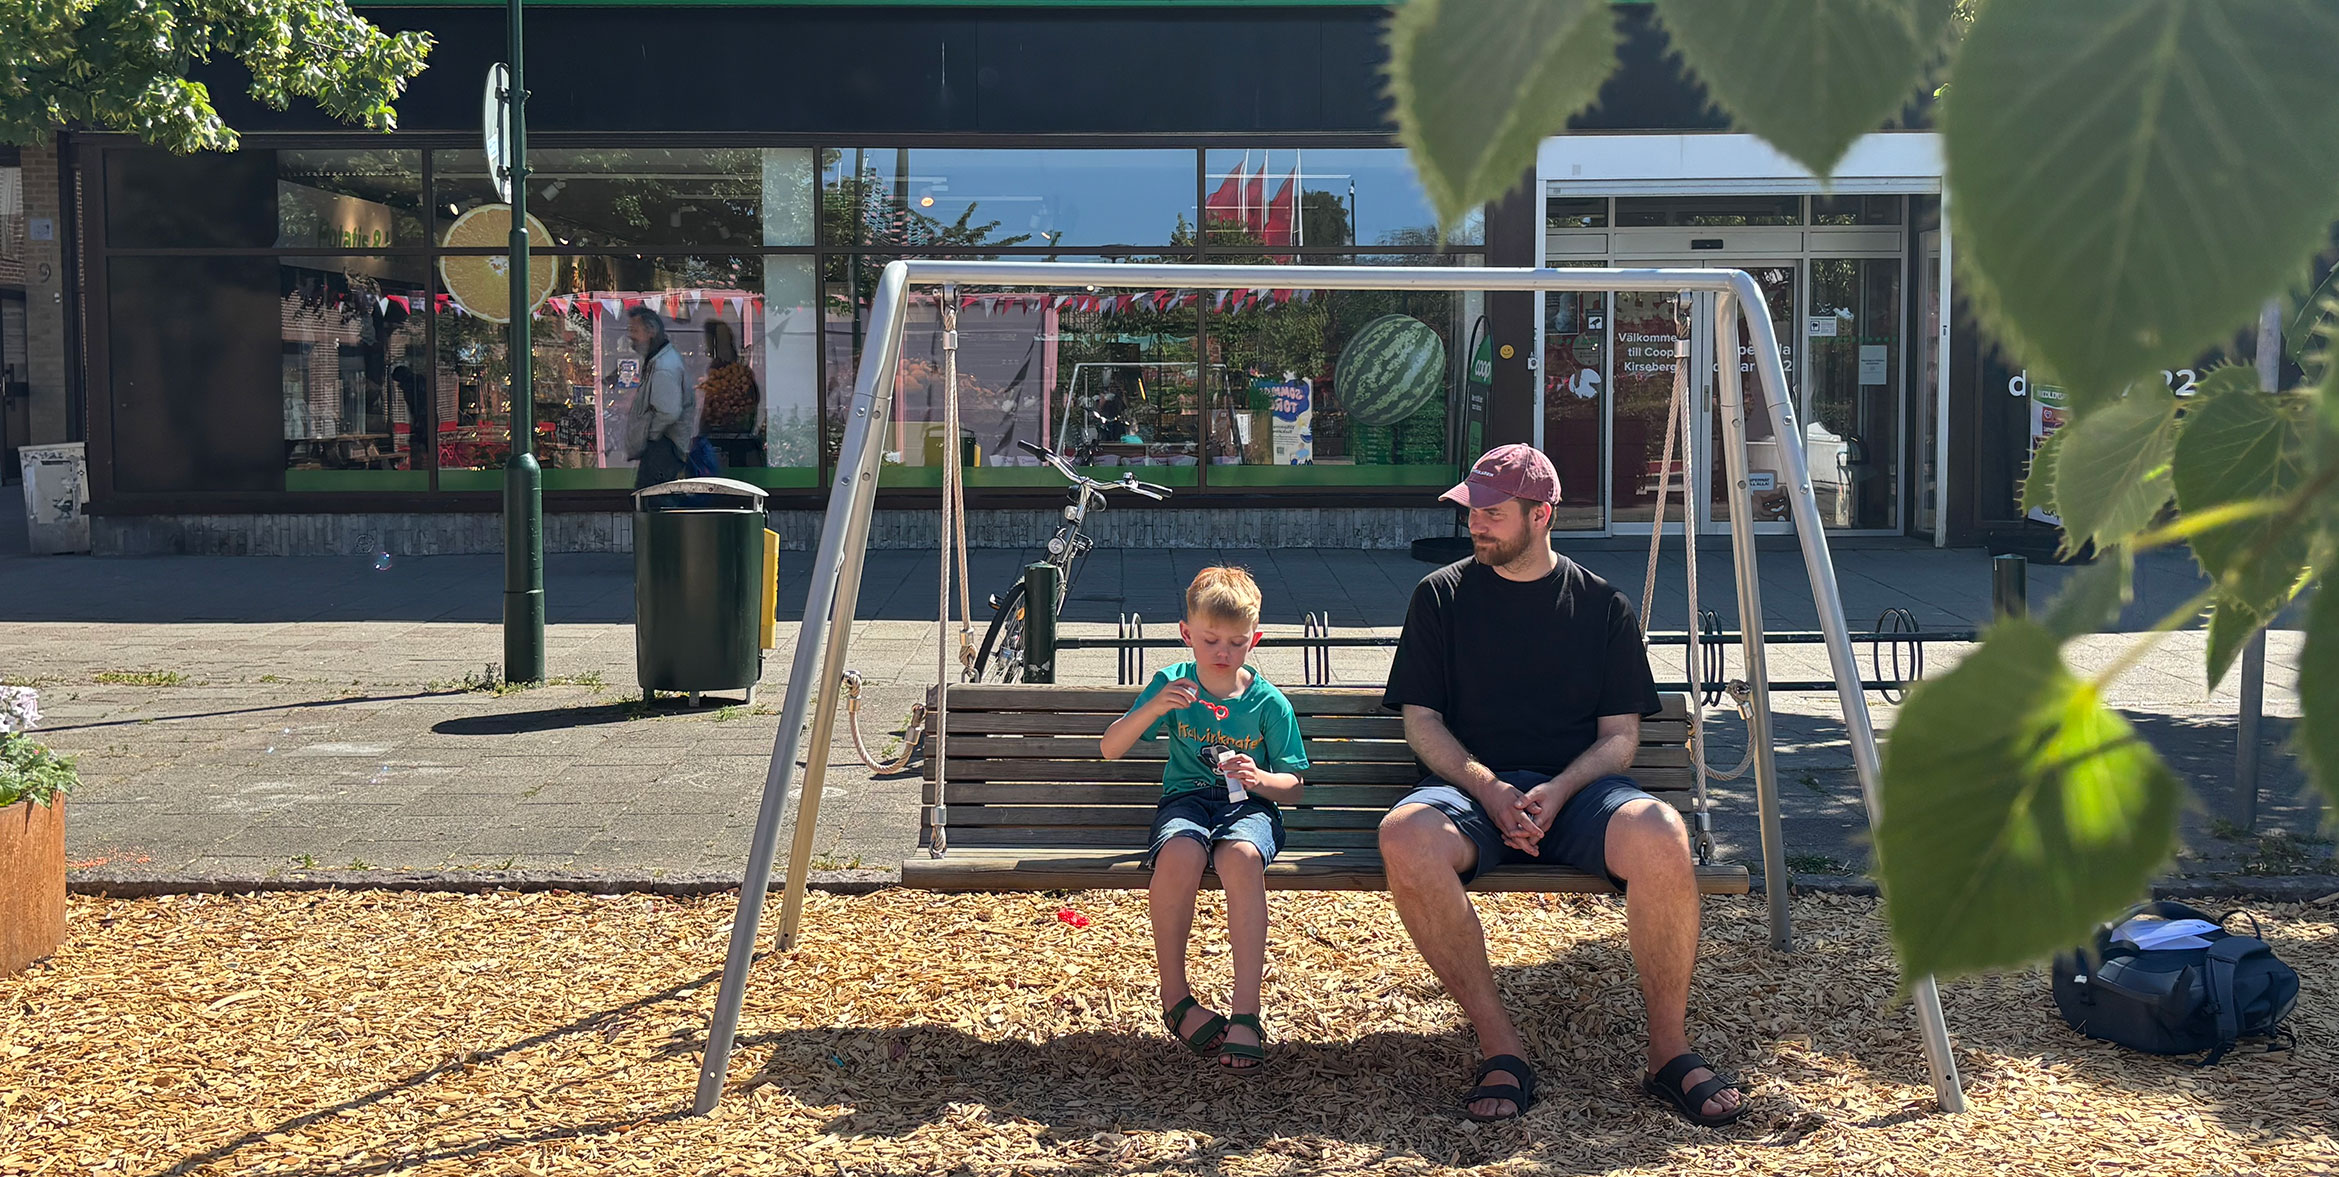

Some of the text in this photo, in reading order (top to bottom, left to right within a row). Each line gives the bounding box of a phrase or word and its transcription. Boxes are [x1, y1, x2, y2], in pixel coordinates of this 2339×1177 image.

[1618, 332, 1677, 342] Välkomme
[1627, 348, 1674, 359] till Coop
[1474, 359, 1491, 382] coop
[1624, 361, 1677, 373] Kirseberg
